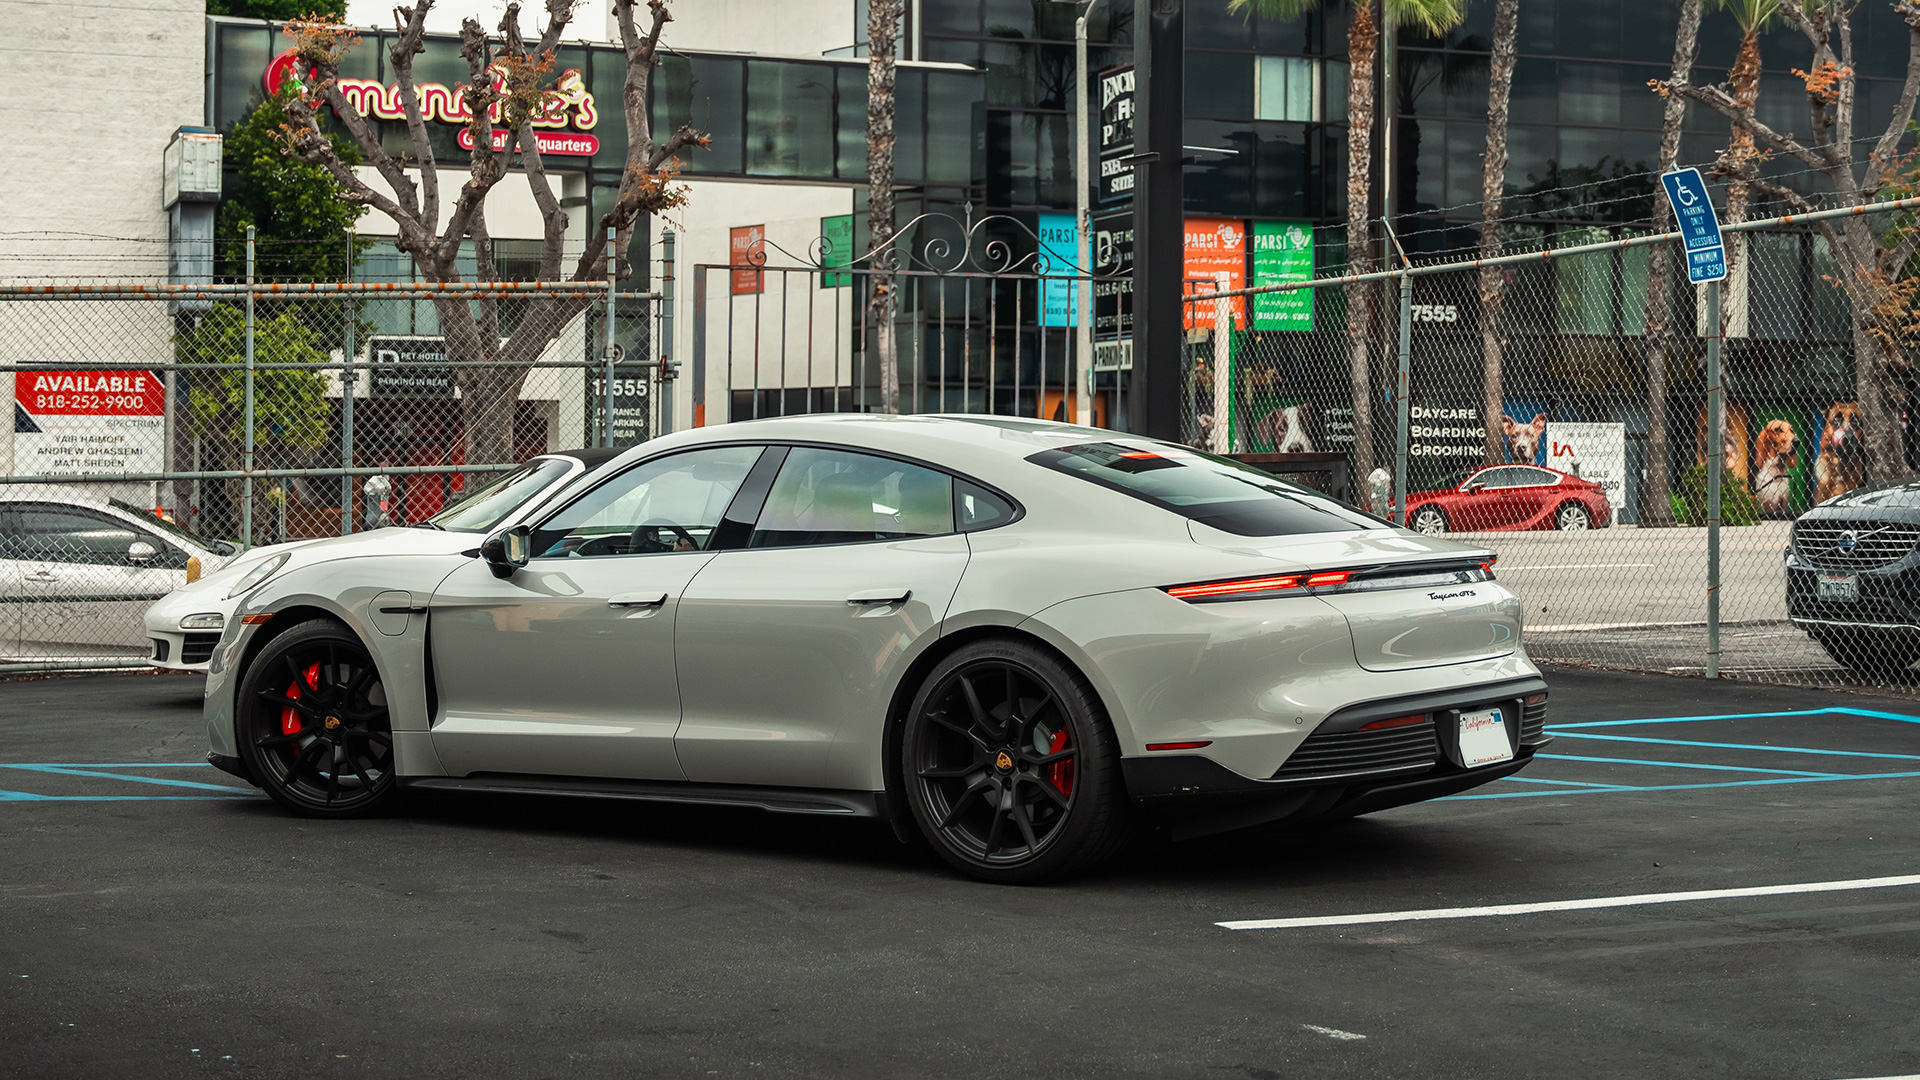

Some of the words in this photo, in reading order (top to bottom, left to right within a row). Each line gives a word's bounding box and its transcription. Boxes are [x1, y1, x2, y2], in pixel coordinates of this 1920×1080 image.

[1683, 205, 1705, 216] PARKING
[1690, 216, 1704, 226] ONLY
[1041, 229, 1075, 243] PARSI
[1694, 226, 1706, 235] VAN
[1184, 233, 1218, 248] PARSI
[1254, 235, 1287, 249] PARSI
[1689, 235, 1718, 248] ACCESSIBLE
[1694, 251, 1718, 264] MINIMUM
[1692, 266, 1704, 278] FINE
[1707, 263, 1723, 276] $250
[33, 376, 146, 392] AVAILABLE
[378, 378, 414, 387] PARKING
[416, 378, 425, 387] IN
[426, 378, 448, 387] REAR
[36, 394, 144, 409] 818-252-9900
[1411, 406, 1477, 419] DAYCARE
[107, 419, 161, 429] SPECTRUM
[1411, 425, 1487, 438] BOARDING
[55, 435, 78, 444] YAIR
[80, 435, 126, 444] HAIMOFF
[37, 447, 84, 456] ANDREW
[1427, 592, 1458, 601] Taycan
